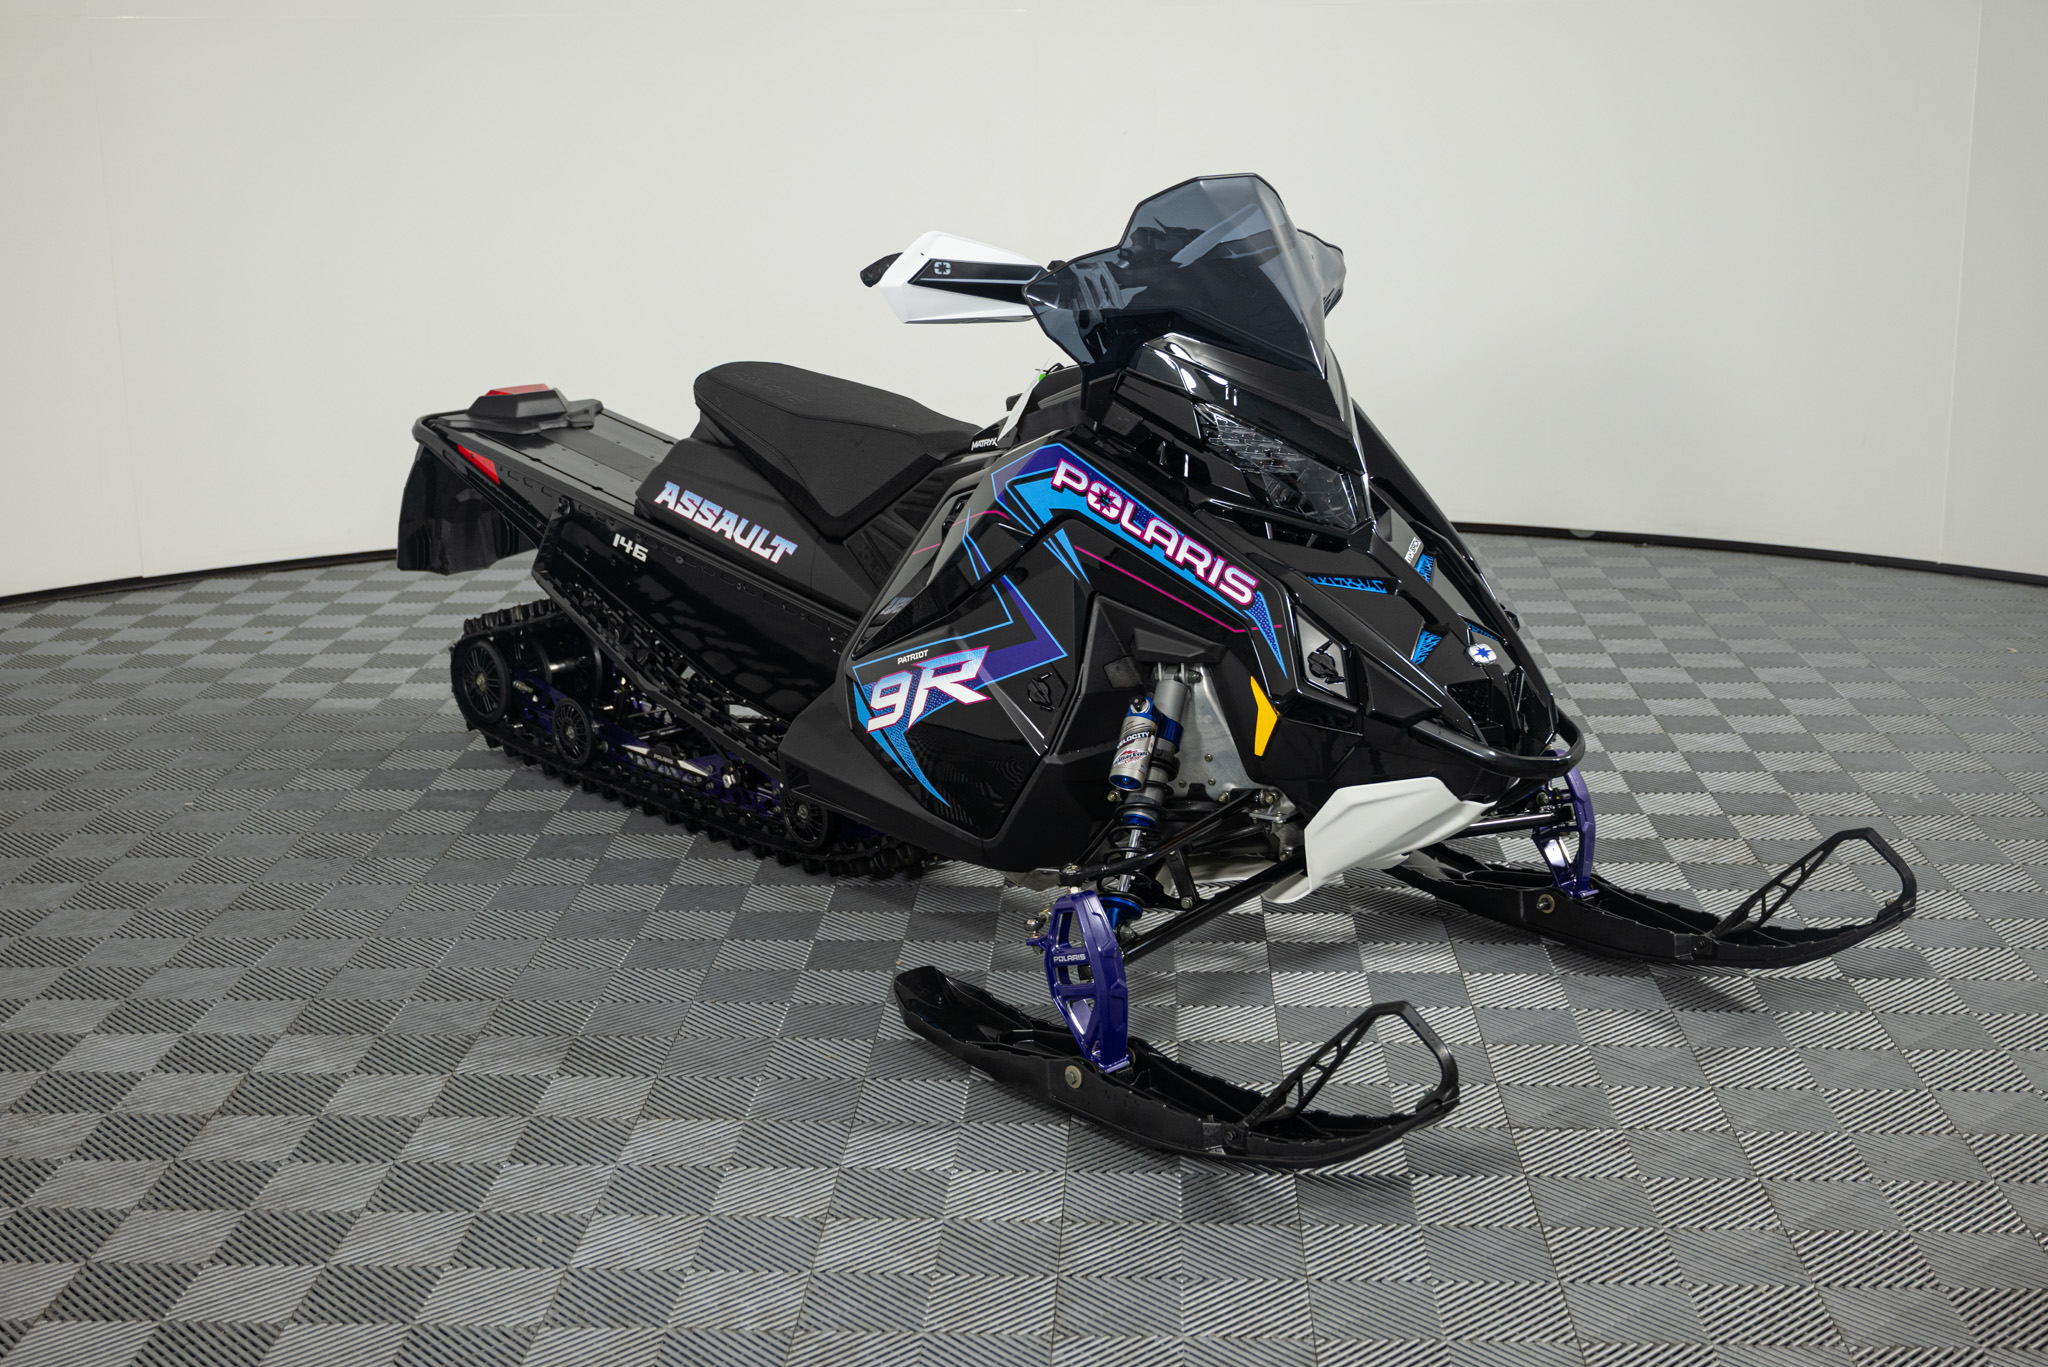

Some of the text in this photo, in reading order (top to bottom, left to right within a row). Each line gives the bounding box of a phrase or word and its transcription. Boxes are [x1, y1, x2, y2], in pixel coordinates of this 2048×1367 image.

[970, 437, 999, 451] MATRYX
[653, 480, 799, 565] ASSAULT
[1050, 457, 1259, 606] POLARIS
[612, 533, 649, 563] 146
[897, 649, 929, 666] PATRIOT
[866, 645, 992, 734] 9R
[1053, 953, 1087, 963] POLARIS
